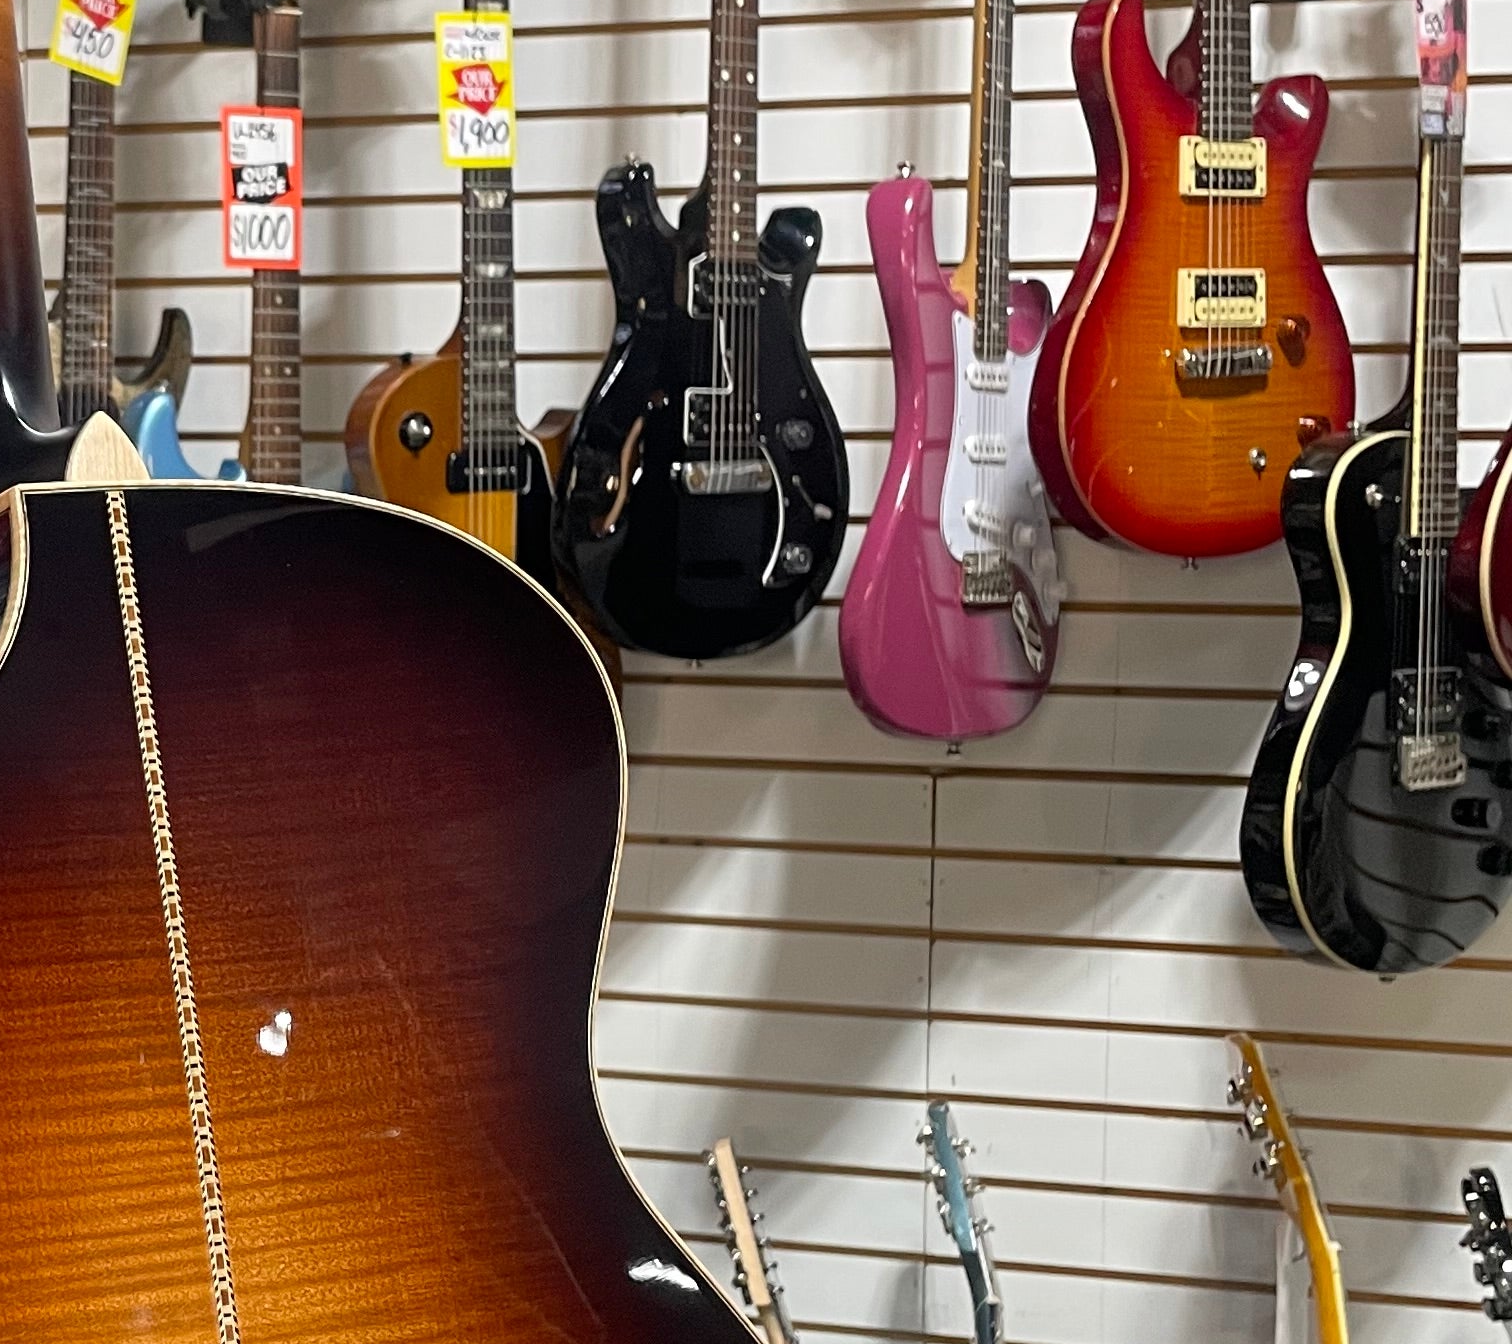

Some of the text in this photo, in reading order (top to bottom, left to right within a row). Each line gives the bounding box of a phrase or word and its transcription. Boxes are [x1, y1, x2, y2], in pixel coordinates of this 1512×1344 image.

[461, 69, 493, 87] OUR
[458, 86, 497, 103] PRICE
[240, 166, 278, 183] OUR
[237, 177, 287, 200] PRICE
[232, 213, 291, 255] $1000
